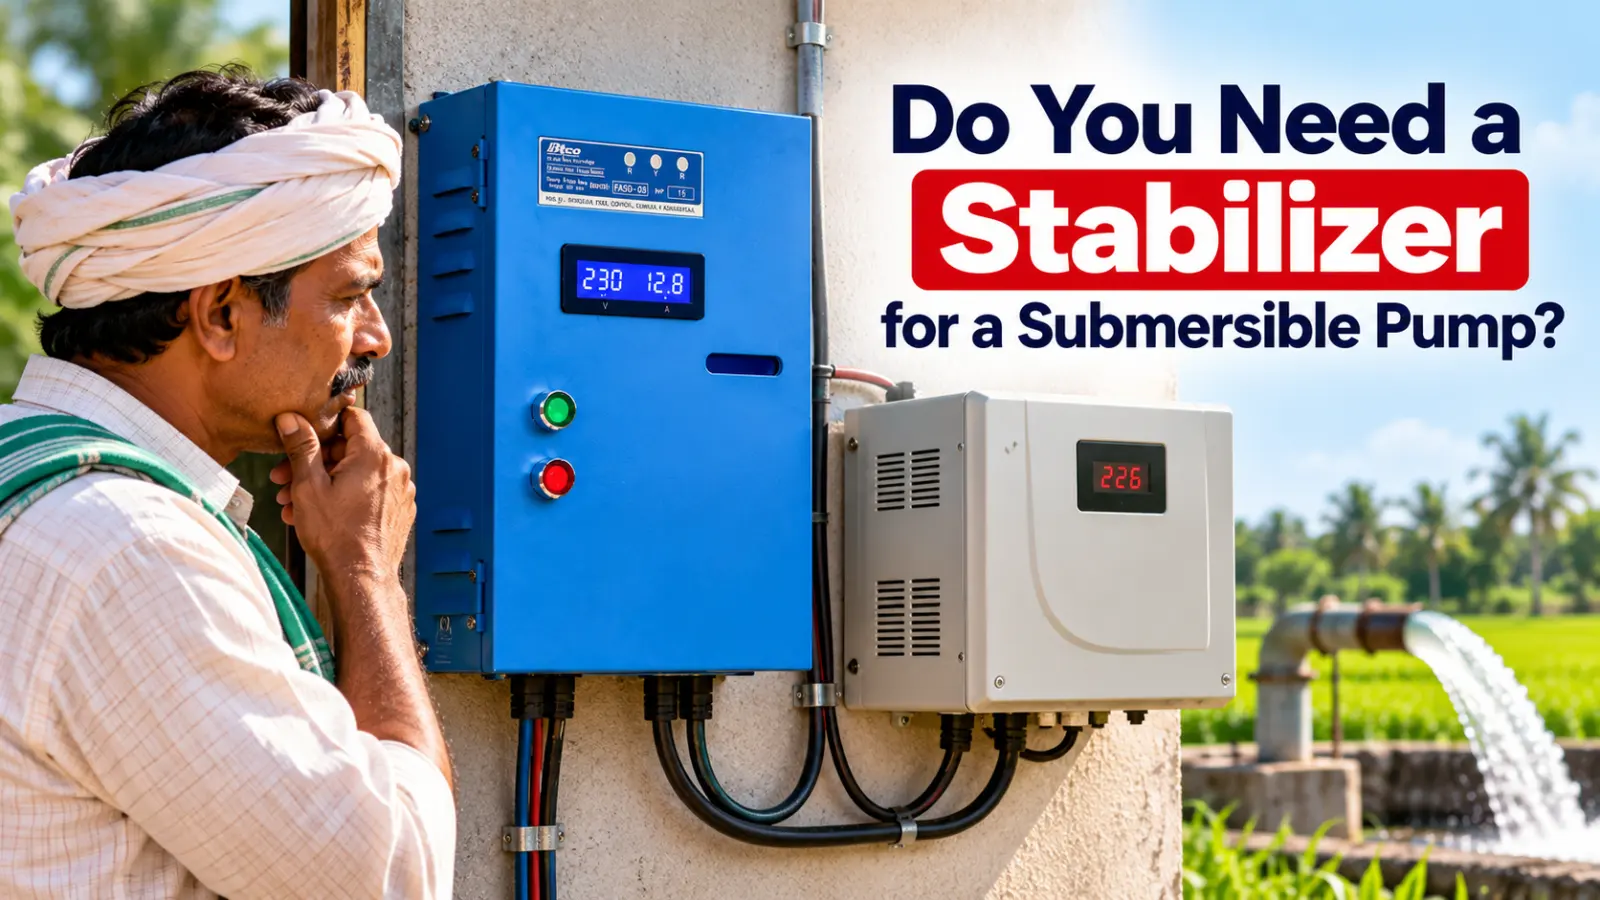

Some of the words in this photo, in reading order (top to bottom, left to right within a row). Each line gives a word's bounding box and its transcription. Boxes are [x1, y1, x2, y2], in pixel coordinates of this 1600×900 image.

[582, 267, 622, 291] 230
[648, 272, 683, 294] 12.8
[602, 302, 609, 310] V
[664, 305, 671, 313] A
[1101, 465, 1142, 490] 226
